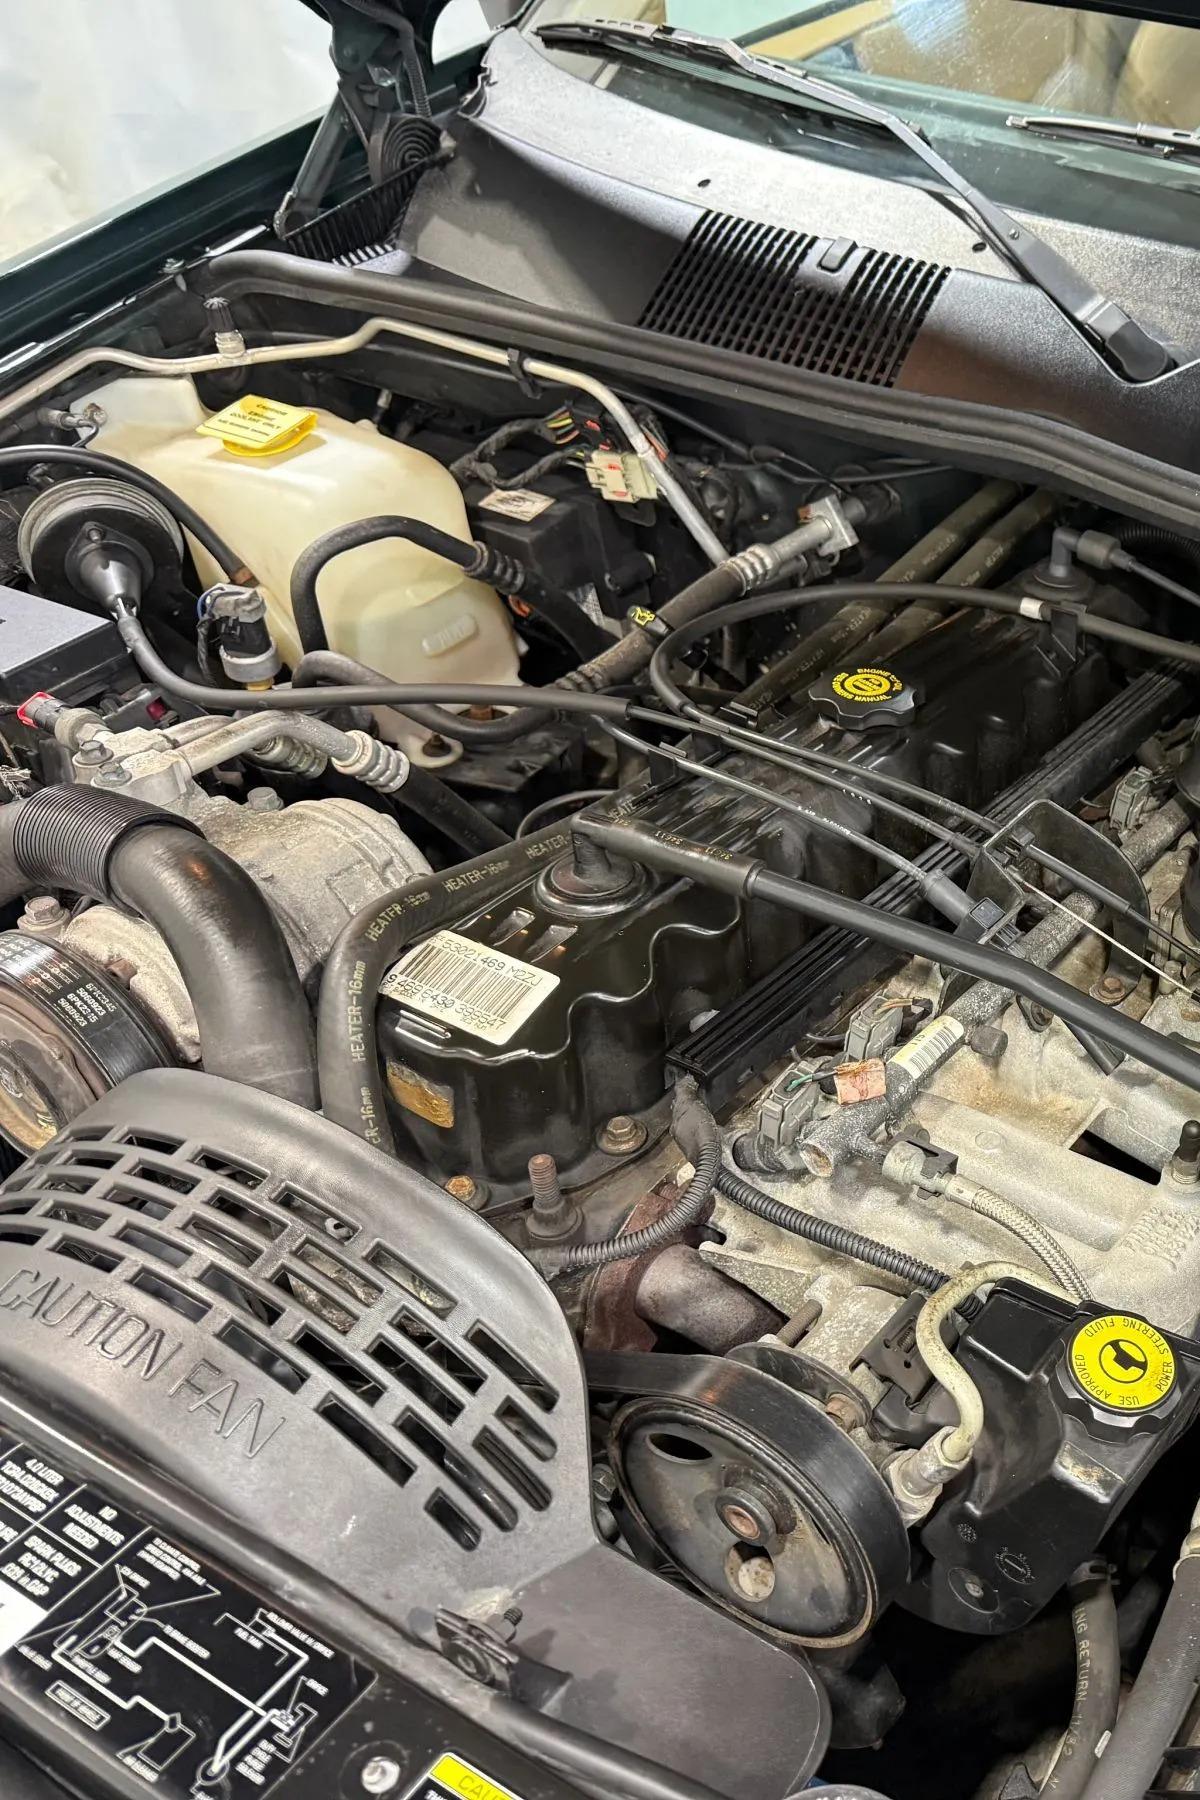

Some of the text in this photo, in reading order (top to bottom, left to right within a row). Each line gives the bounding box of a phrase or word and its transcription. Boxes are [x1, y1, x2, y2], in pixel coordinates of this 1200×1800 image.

[0, 1269, 287, 1459] CAUTION FAN
[1084, 1317, 1173, 1393] POWER STEERING FLUID
[1074, 1354, 1140, 1406] USE APPROVED
[24, 1457, 45, 1473] 4.0
[64, 1503, 126, 1546] ADJUSTMENTS
[98, 1505, 119, 1521] NO
[23, 1535, 55, 1559] SPARK
[62, 1522, 100, 1550] NEEDED
